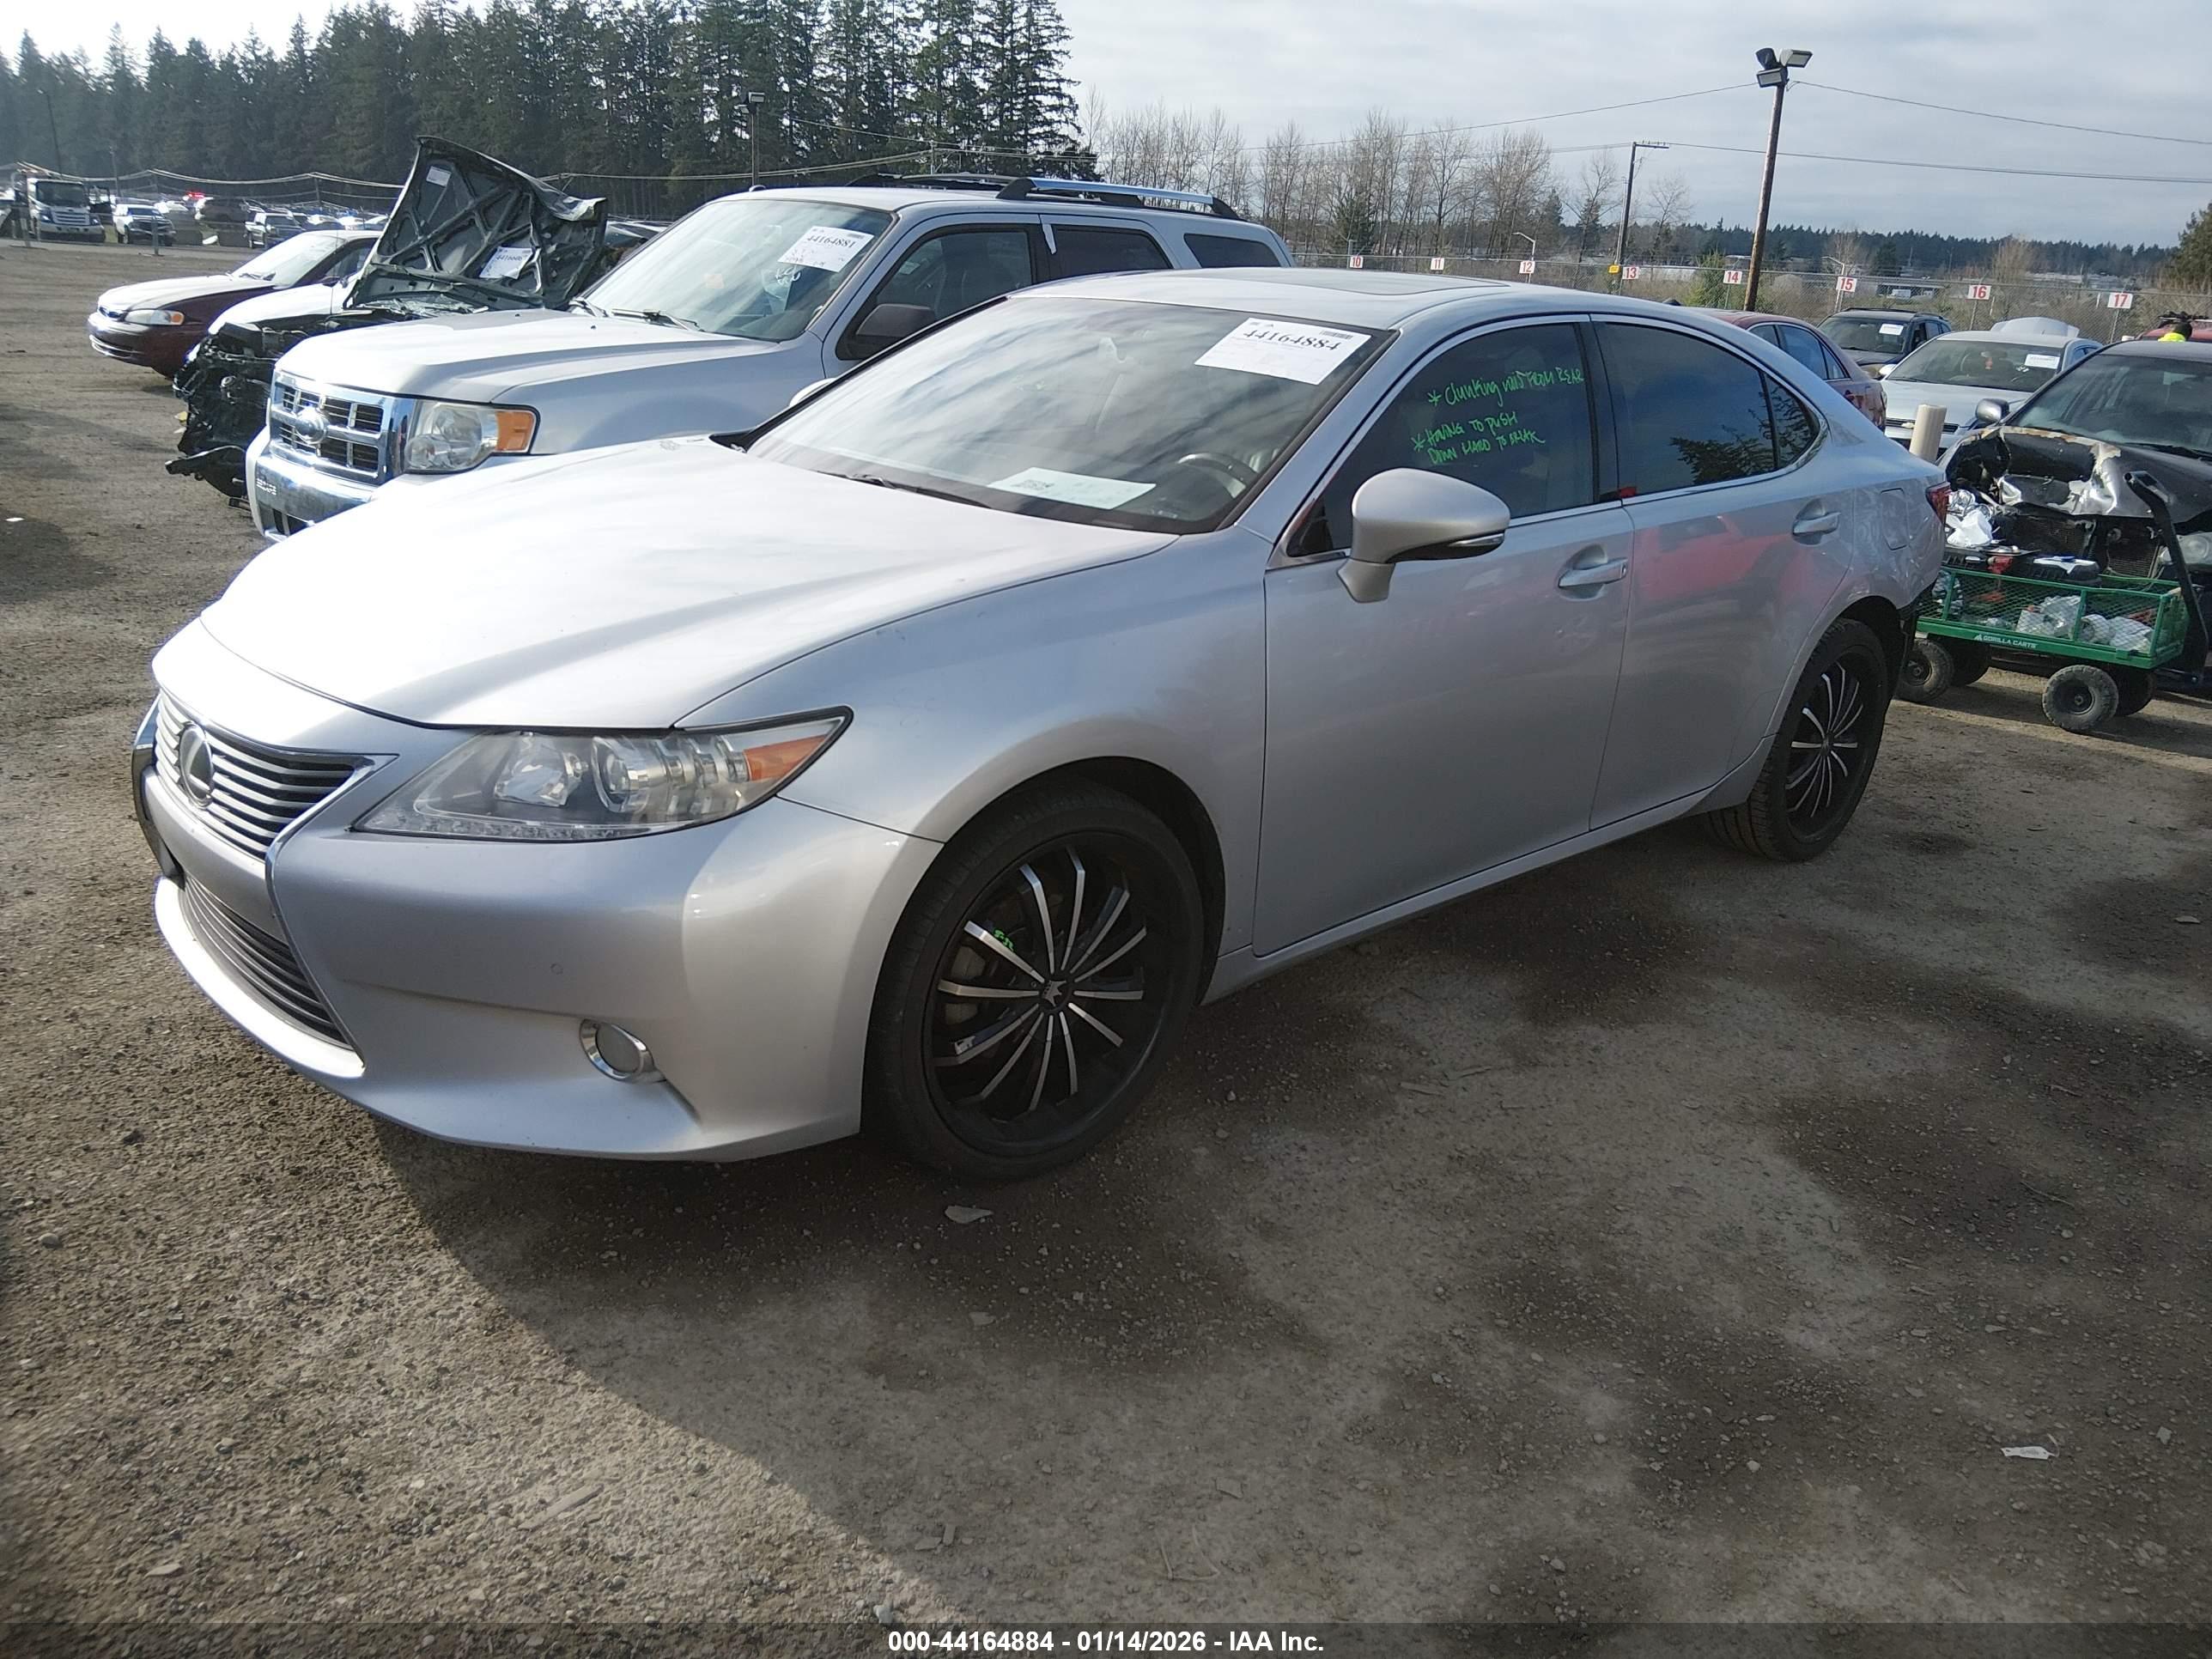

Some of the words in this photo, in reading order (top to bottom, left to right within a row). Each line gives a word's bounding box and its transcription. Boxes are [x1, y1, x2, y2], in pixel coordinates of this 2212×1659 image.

[1352, 257, 1361, 267] 10
[1435, 258, 1442, 269] 11
[1522, 261, 1532, 272] 12
[1626, 267, 1637, 278] 13
[1728, 272, 1739, 283] 14
[1841, 278, 1853, 289] 15
[1973, 286, 1986, 298] 16
[2114, 294, 2127, 307] 17
[1243, 330, 1341, 350] 44164884
